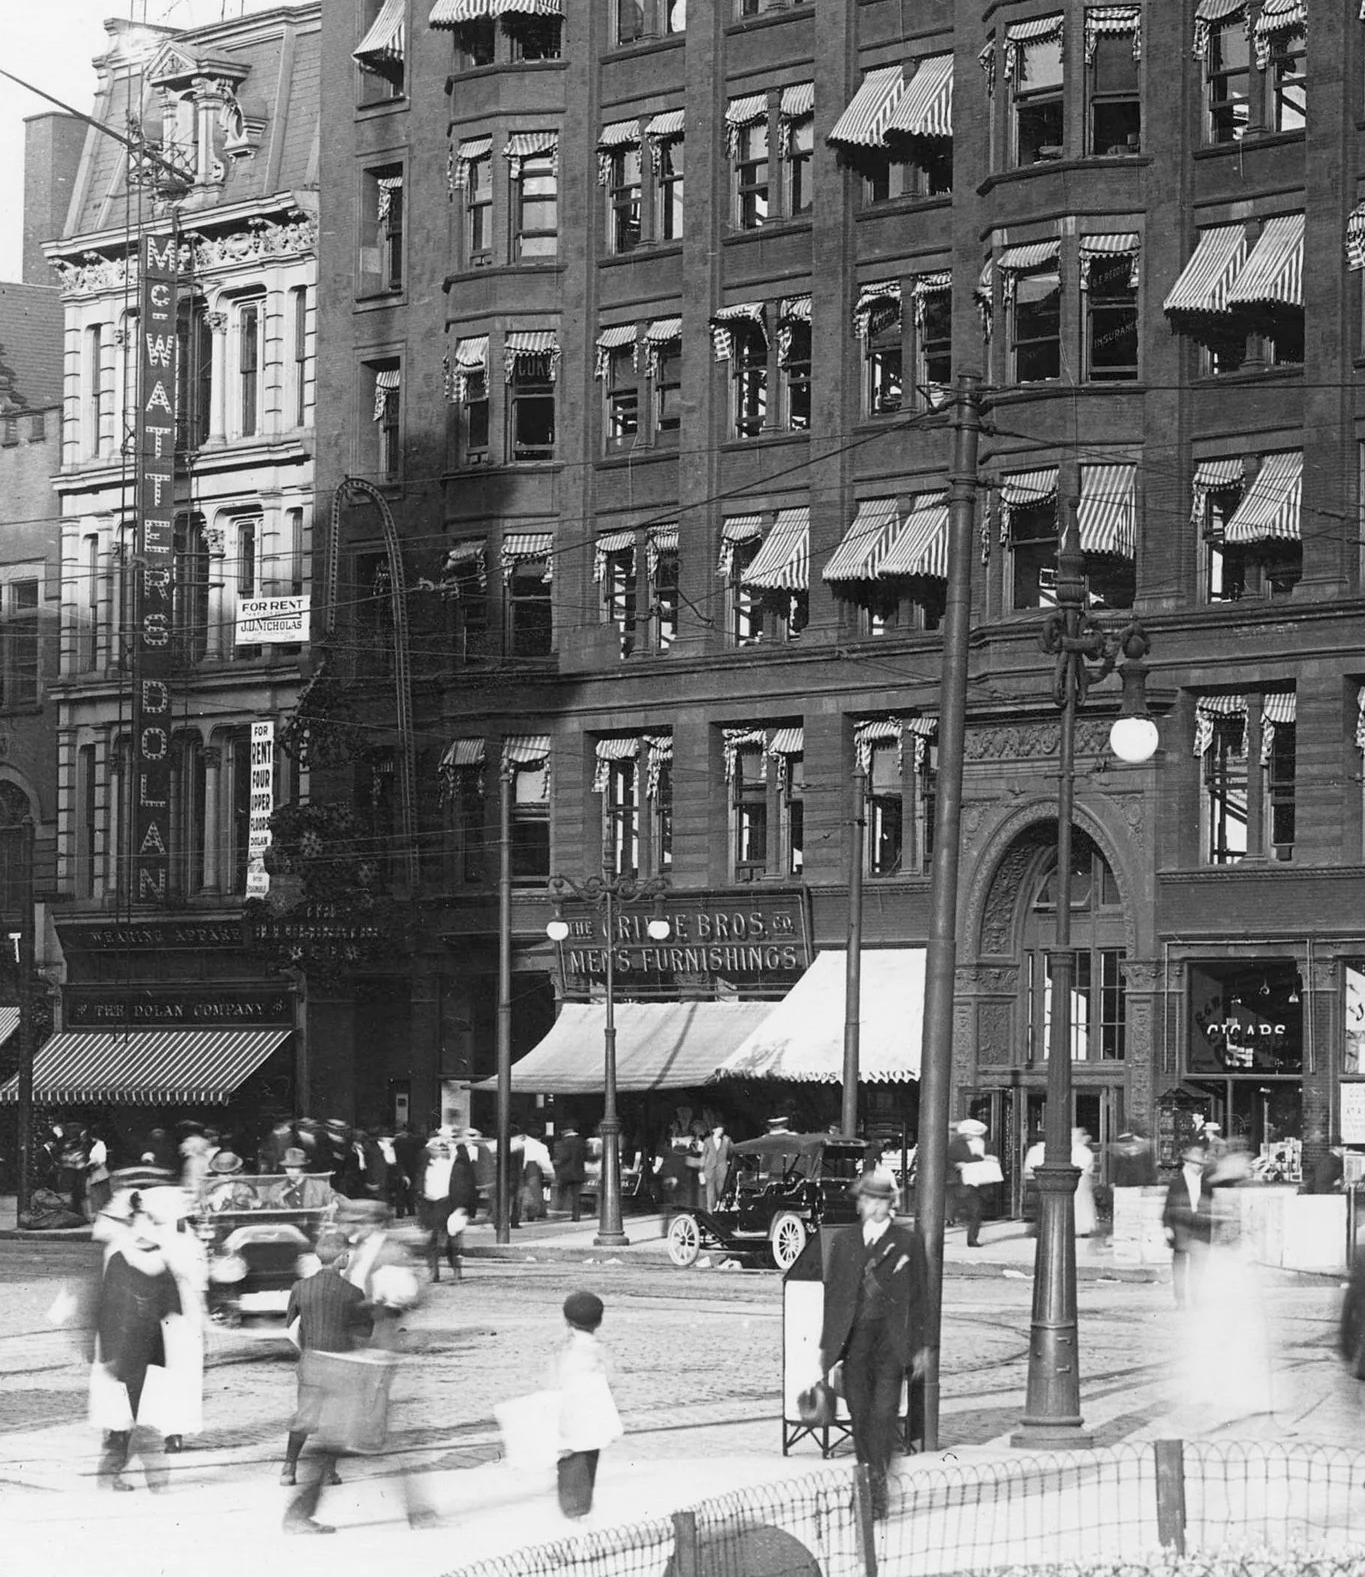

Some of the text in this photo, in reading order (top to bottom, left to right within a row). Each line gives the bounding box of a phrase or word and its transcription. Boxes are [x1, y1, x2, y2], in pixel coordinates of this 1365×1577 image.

[242, 599, 303, 613] FOR RENT
[253, 725, 269, 737] FOR
[250, 740, 273, 765] RENT
[139, 678, 169, 901] DOLAN
[251, 769, 272, 790] FOUR
[697, 911, 770, 938] BROS.
[641, 945, 797, 972] FURNISHINGS
[95, 1002, 265, 1018] THE DOLAN COMPANY
